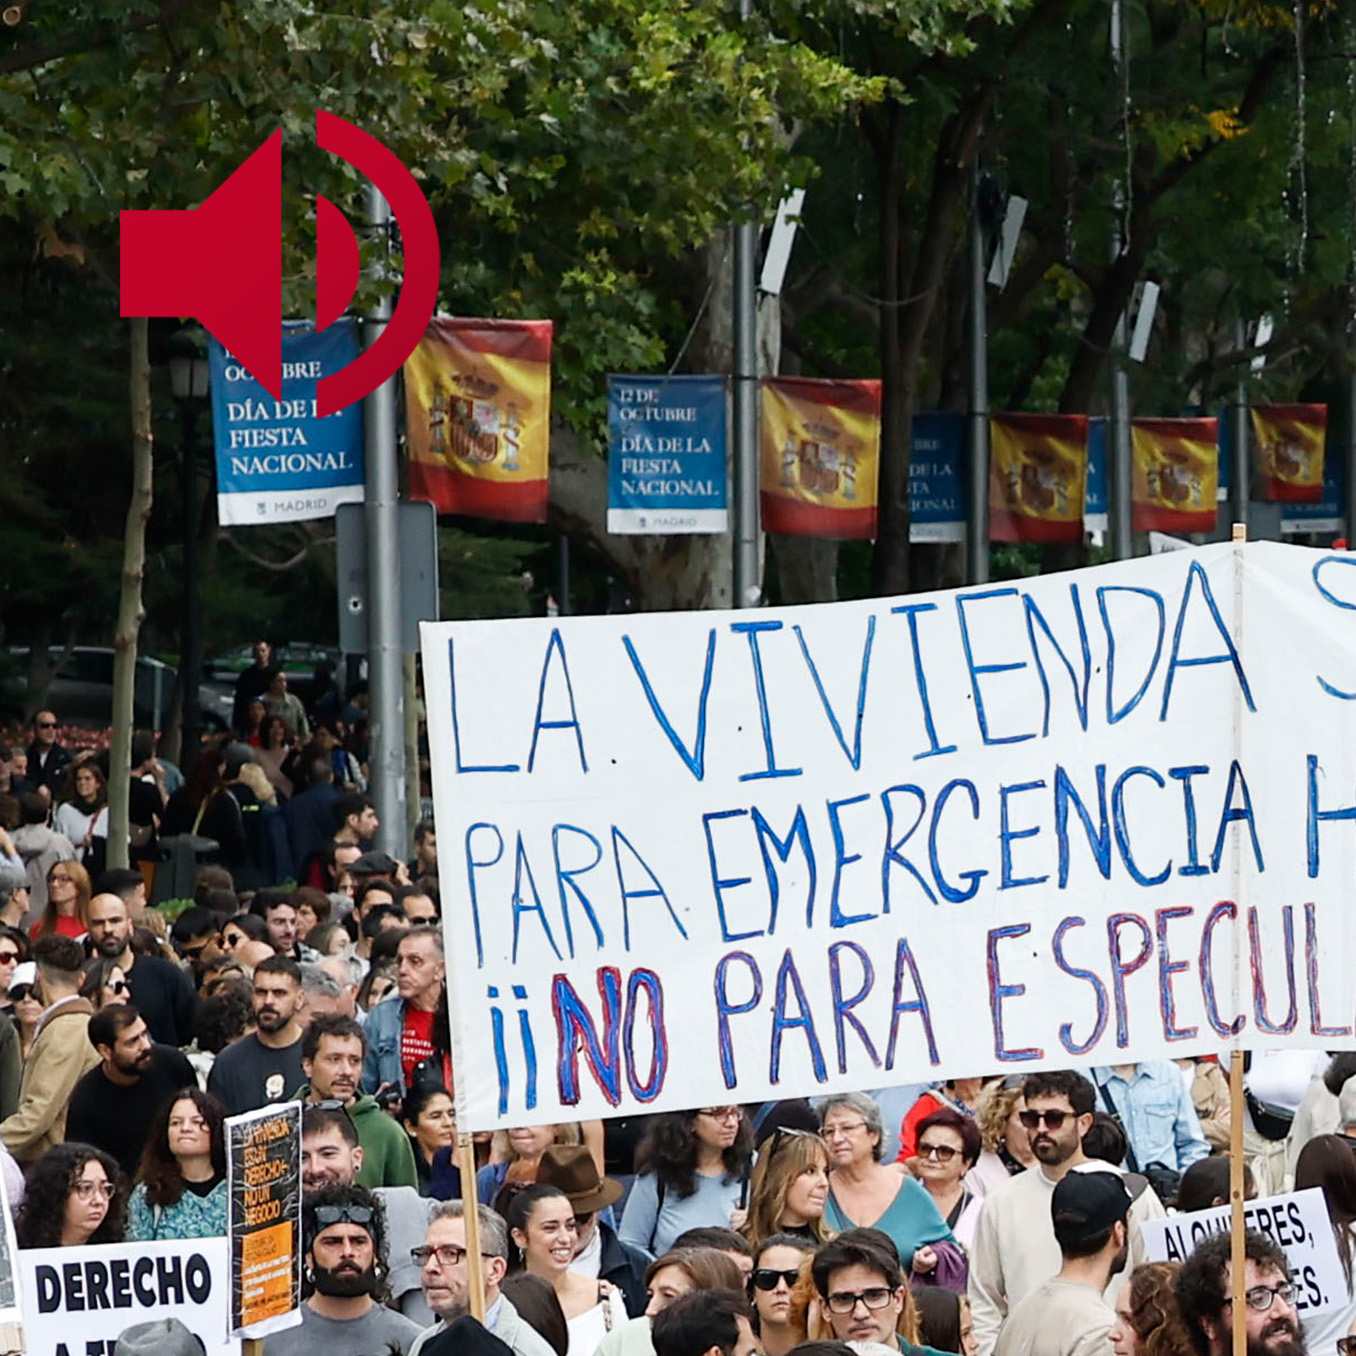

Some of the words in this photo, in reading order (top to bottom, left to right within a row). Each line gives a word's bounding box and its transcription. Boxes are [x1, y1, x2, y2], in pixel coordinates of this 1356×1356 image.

[225, 361, 322, 381] OCBRE
[228, 398, 270, 422] DÍA
[275, 400, 307, 419] DE
[620, 407, 697, 422] OCTUBRE
[230, 427, 308, 448] FIESTA
[622, 434, 653, 453] DÍA
[658, 437, 683, 453] DE
[687, 437, 712, 453] LA
[232, 451, 353, 476] NACIONAL
[622, 458, 682, 475] FIESTA
[621, 480, 719, 496] NACIONAL
[274, 498, 328, 513] MADRID
[449, 627, 589, 774] LA
[622, 559, 1257, 782] VIVIENDA
[465, 822, 688, 969] PARA
[702, 760, 1264, 943] EMERGENCIA
[714, 934, 940, 1090] PARA
[35, 1253, 212, 1314] DERECHO
